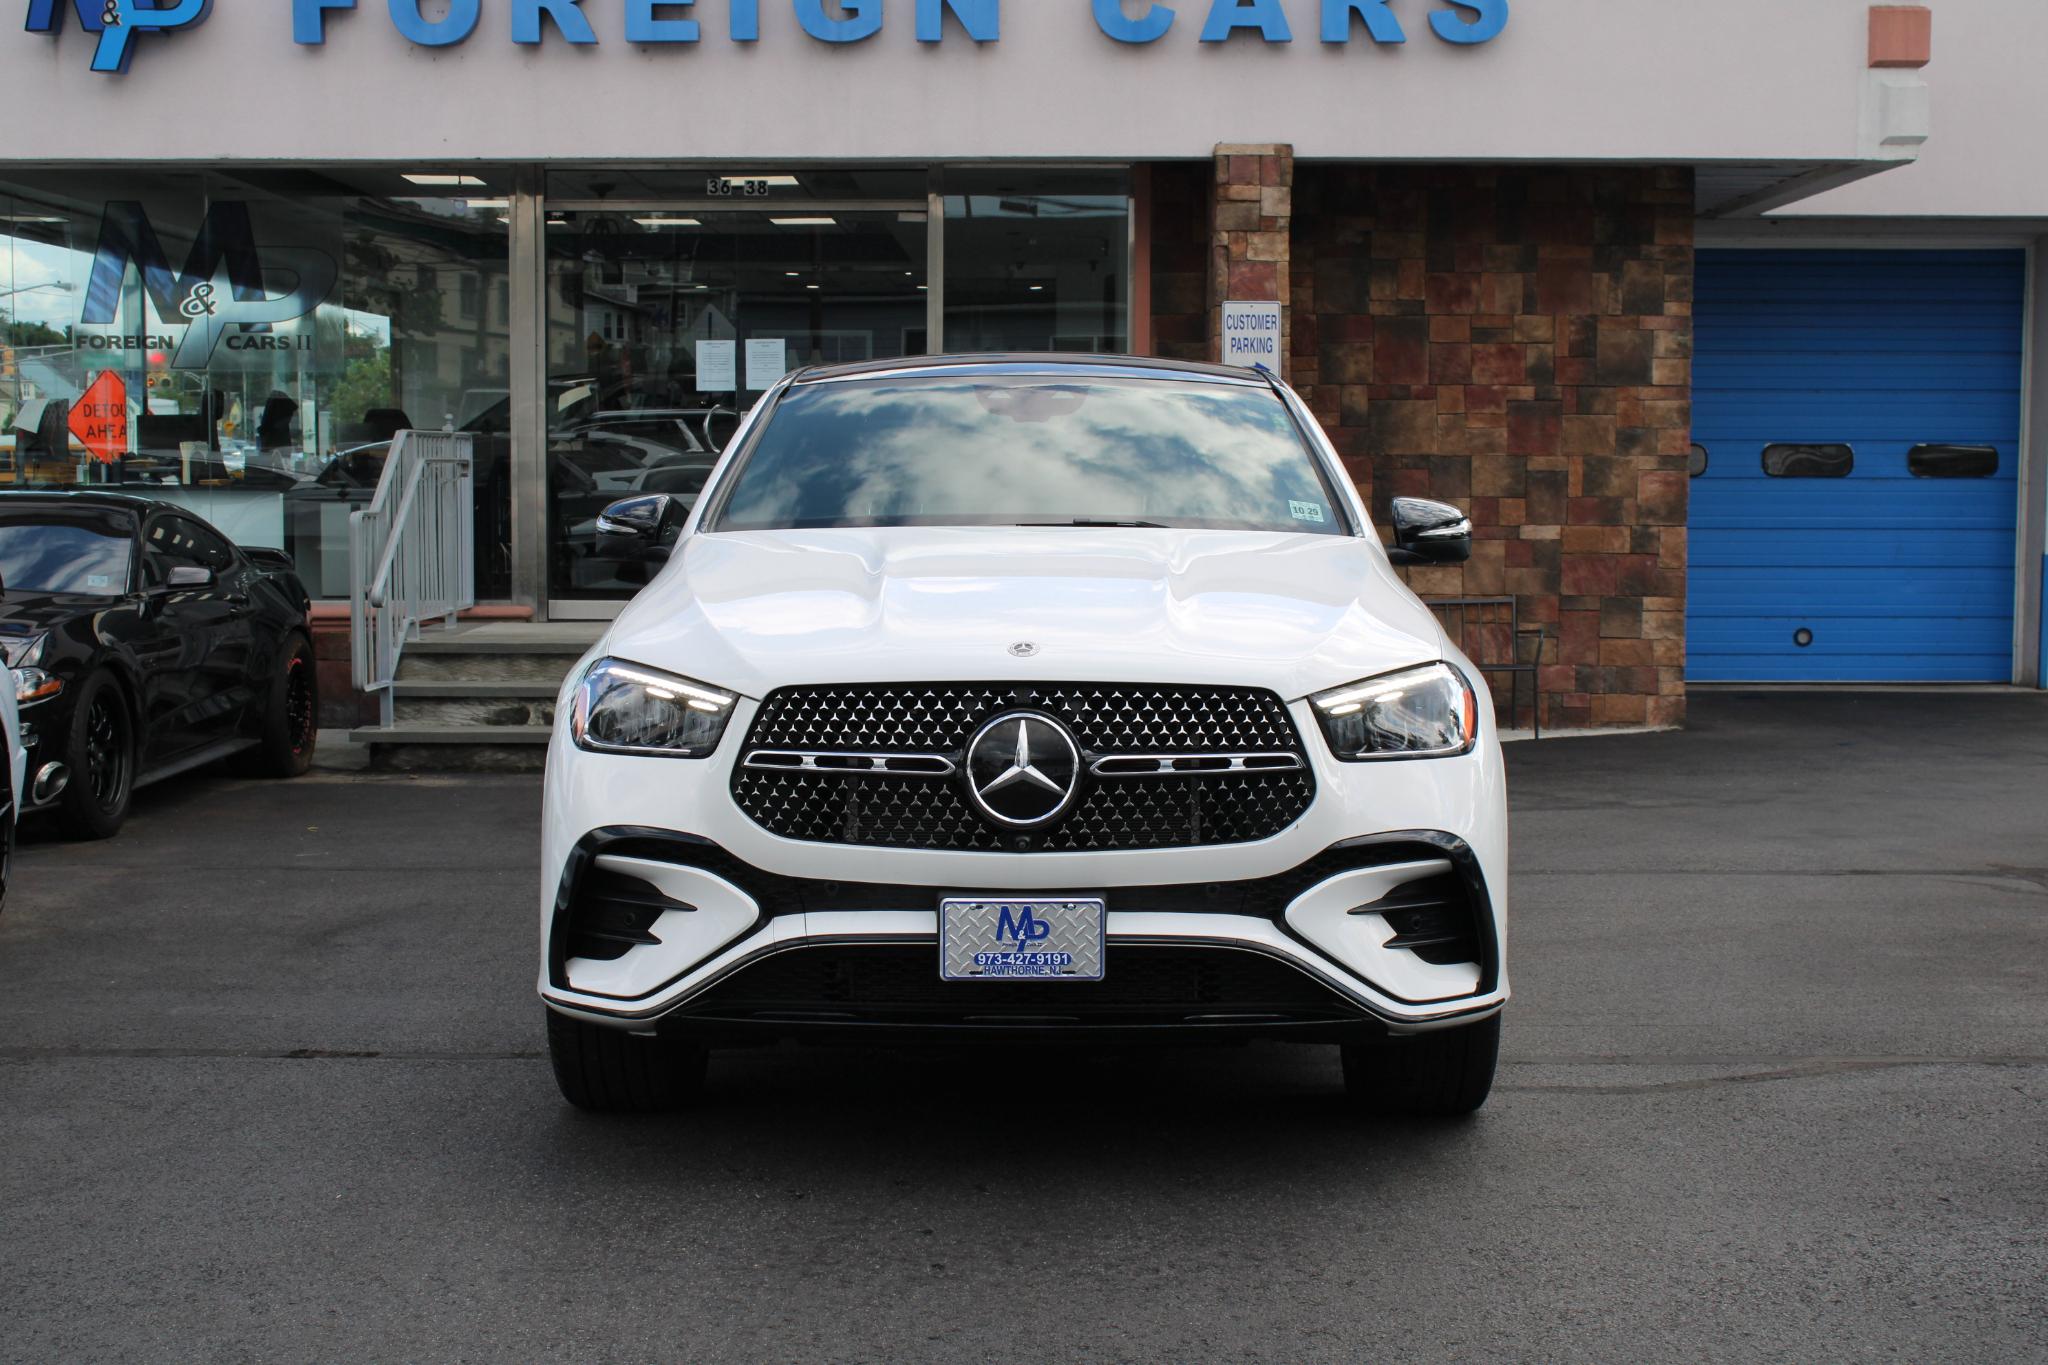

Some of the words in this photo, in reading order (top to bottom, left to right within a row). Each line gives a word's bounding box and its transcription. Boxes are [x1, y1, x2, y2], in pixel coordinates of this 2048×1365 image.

[1226, 314, 1278, 330] CUSTOMER
[76, 335, 174, 350] FOREIGN
[226, 335, 290, 350] CARS
[1230, 337, 1273, 354] PARKING
[83, 403, 126, 418] DETOU
[86, 424, 126, 439] AHEA
[1292, 505, 1305, 515] 10
[977, 953, 1068, 965] 973-427-9191
[1049, 965, 1061, 975] NJ
